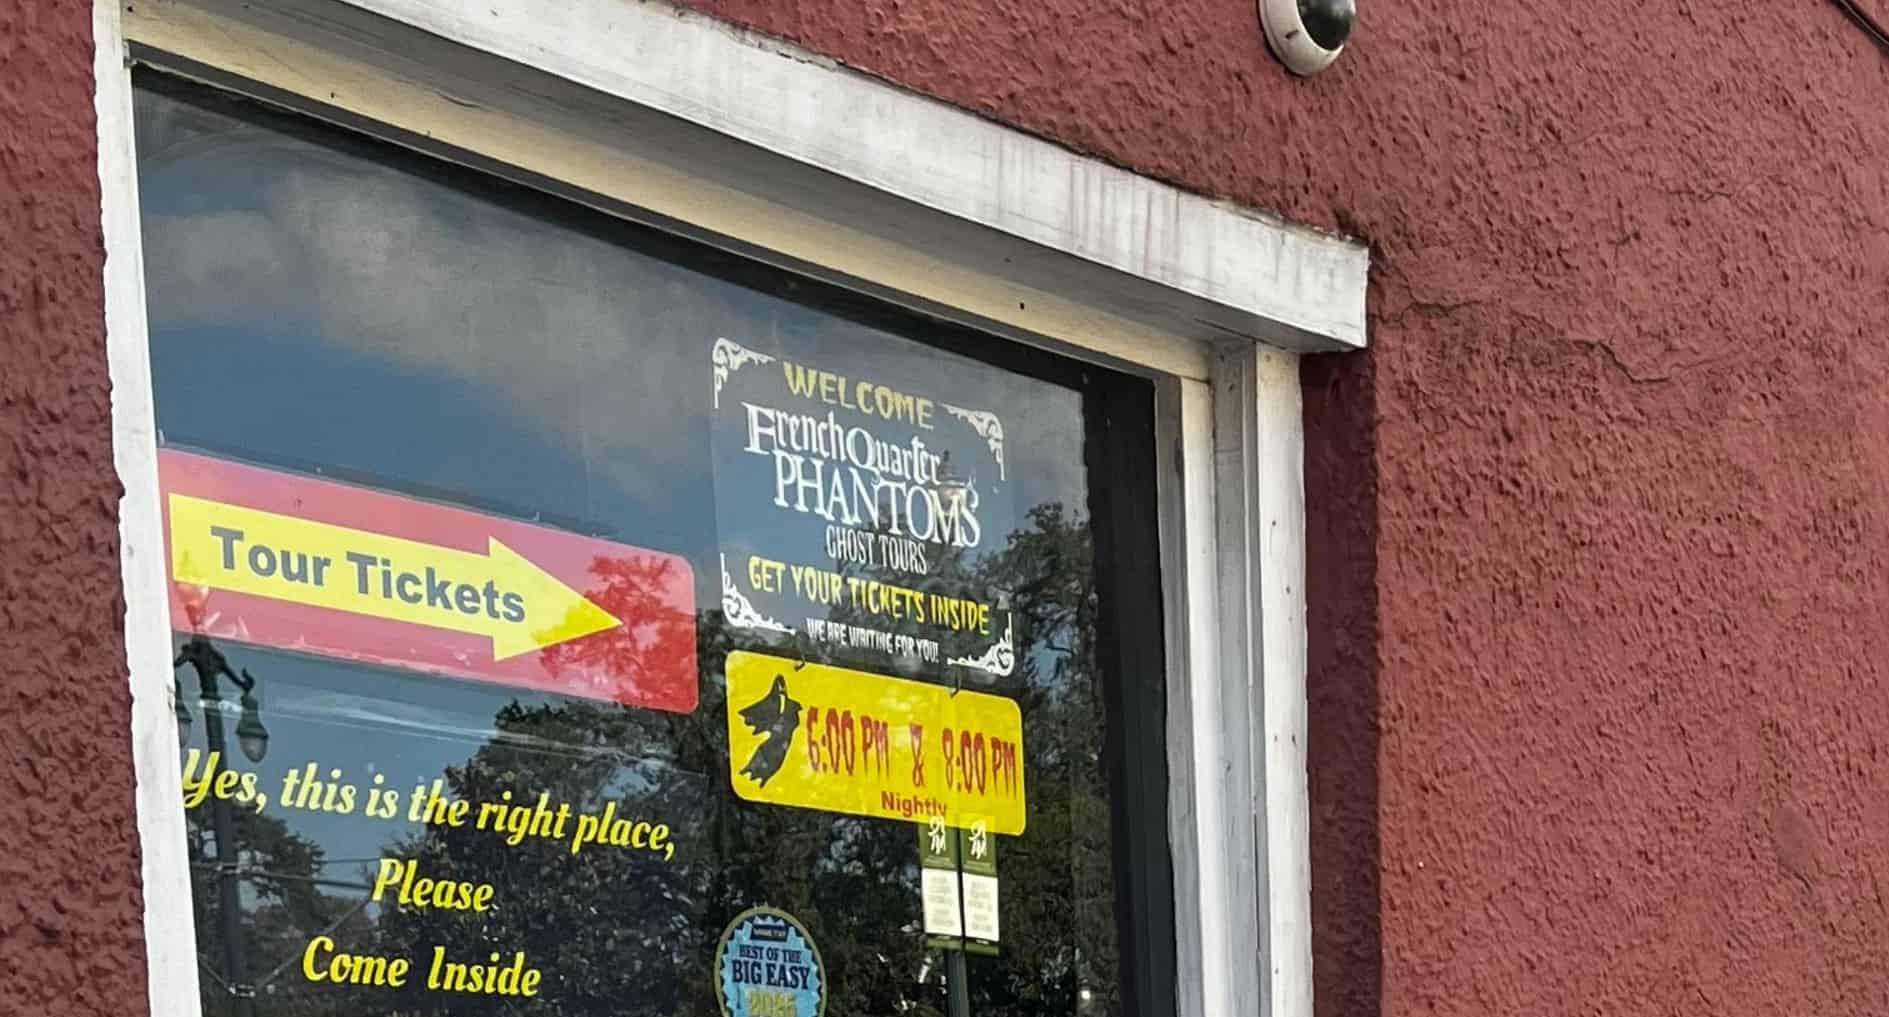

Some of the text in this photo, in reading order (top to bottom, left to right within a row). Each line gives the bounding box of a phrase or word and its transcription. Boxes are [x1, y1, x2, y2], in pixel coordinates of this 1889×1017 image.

[784, 361, 934, 429] WELCOME
[772, 450, 981, 548] PHANTOMS
[211, 526, 525, 623] Tour Tickets
[827, 525, 927, 575] GHOST TOURS
[749, 557, 989, 636] GET YOUR TICKETS INSIDE
[806, 618, 827, 642] WE
[828, 624, 847, 644] ARE
[849, 628, 893, 653] WAITING
[895, 636, 914, 658] FOR
[806, 707, 1017, 800] 6:00 PM & 8:00 PM
[182, 749, 676, 860] Yes, this is the right place,
[881, 791, 947, 818] Nightly
[372, 858, 494, 911] Please
[303, 935, 541, 996] Come Inside
[732, 960, 810, 989] BIG EASY
[739, 944, 802, 963] BEST OF THE
